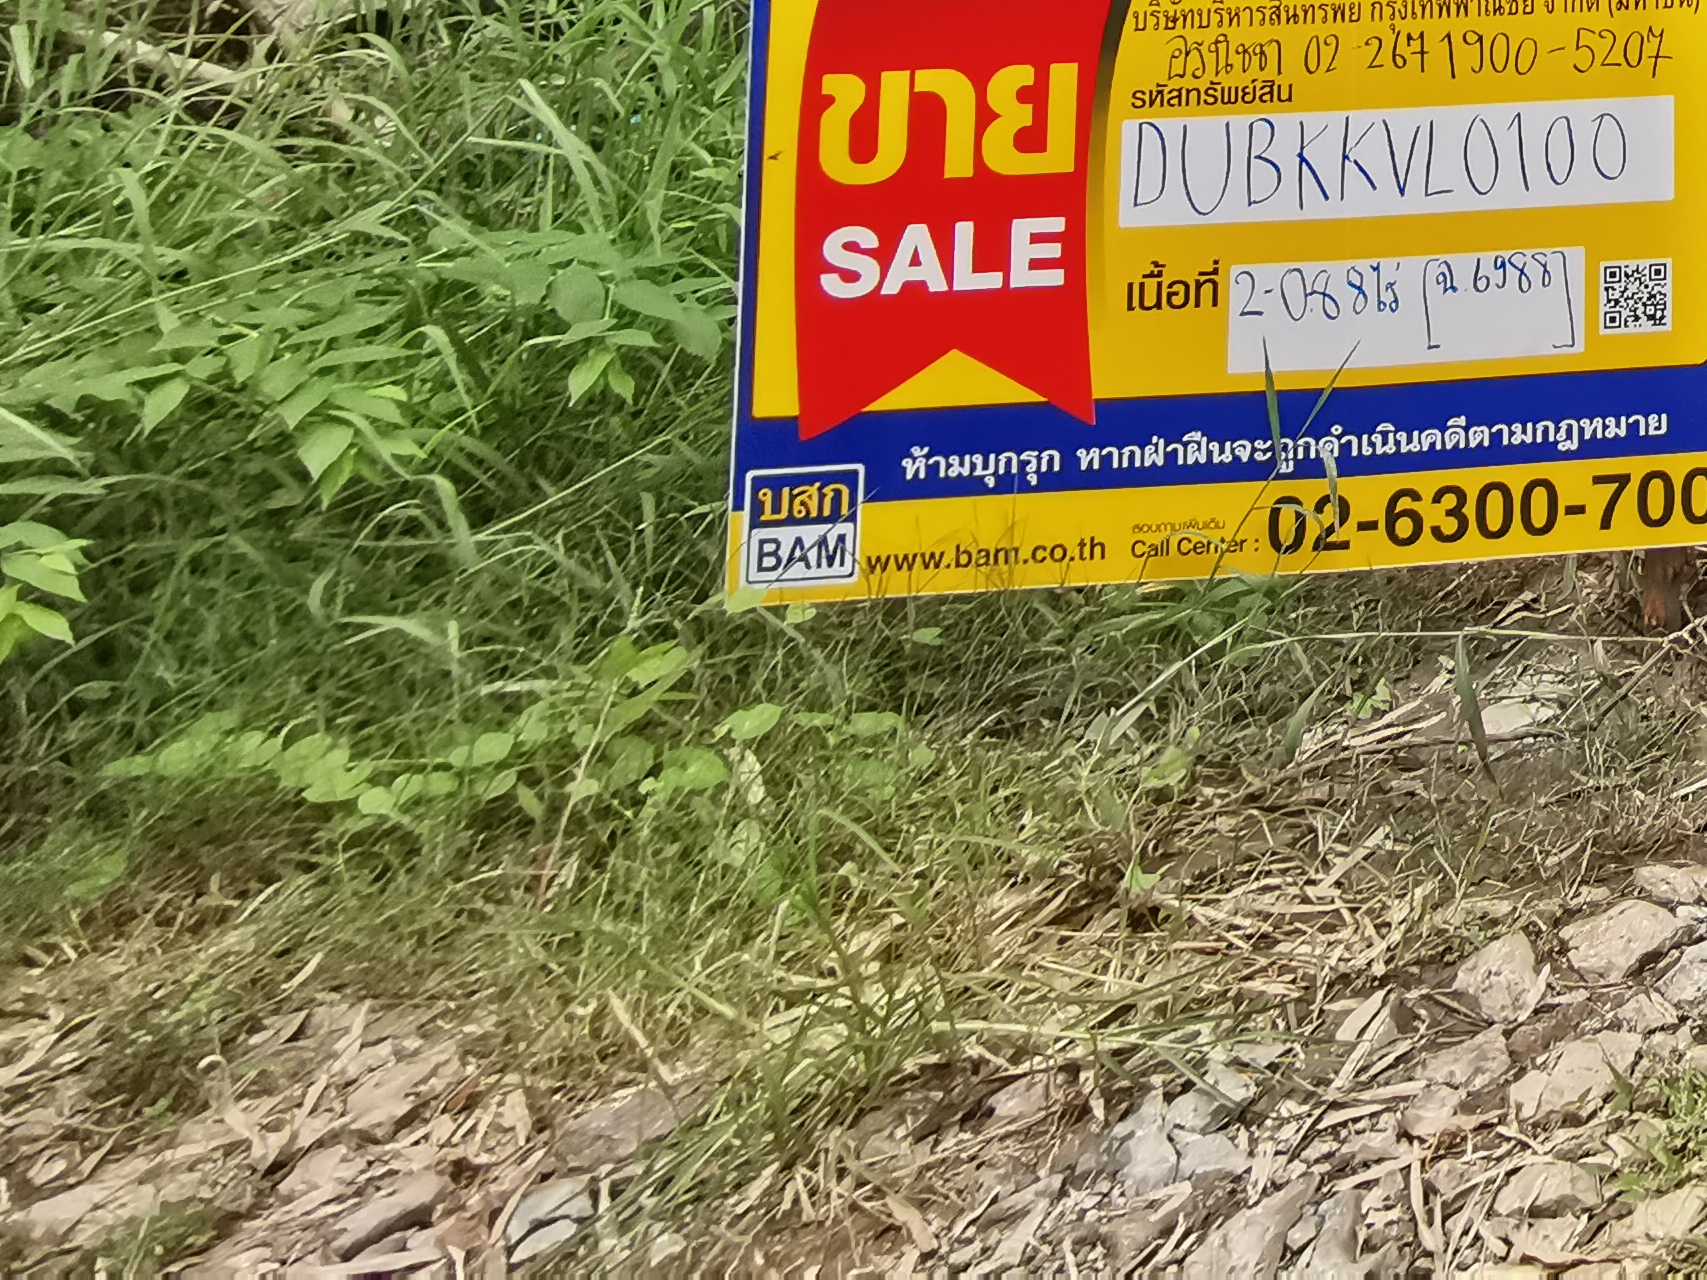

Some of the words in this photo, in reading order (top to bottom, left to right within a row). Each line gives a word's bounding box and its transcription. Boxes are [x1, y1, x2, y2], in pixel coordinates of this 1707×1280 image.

[1303, 33, 1341, 76] 02
[1130, 78, 1294, 109] รหัสทรัพย์สิน
[818, 62, 1079, 186] ขาย
[820, 216, 1066, 299] SALE
[1125, 258, 1221, 312] เนื้อที่
[901, 445, 1061, 488] ห้ามบุกรุก
[757, 481, 851, 522] บสก
[755, 533, 848, 574] BAM
[865, 536, 1107, 576] www.bam.co.th
[1130, 536, 1171, 559] Call
